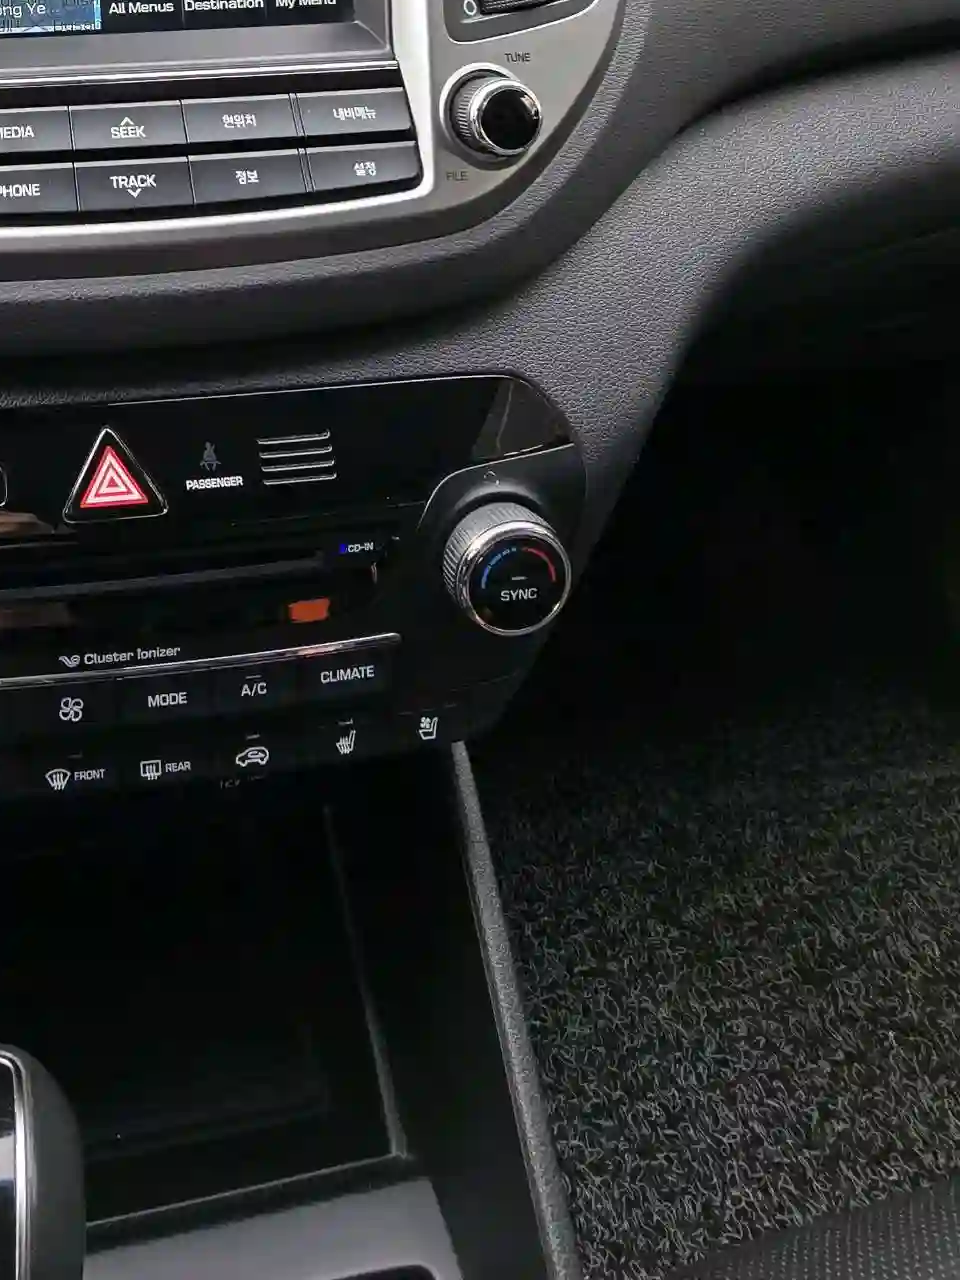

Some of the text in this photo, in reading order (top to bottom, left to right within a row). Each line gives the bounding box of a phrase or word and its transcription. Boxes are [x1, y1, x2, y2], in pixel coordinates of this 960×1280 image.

[109, 1, 174, 14] All Menus
[504, 52, 531, 63] TUNE
[110, 124, 147, 139] SEEK
[109, 173, 157, 190] TRACK
[185, 475, 244, 491] PASSENGER
[347, 541, 375, 553] CD-IN
[500, 587, 538, 601] SYNC
[83, 651, 134, 665] Cluster
[320, 664, 375, 684] CLIMATE
[240, 681, 268, 697] A/C
[147, 691, 188, 708] MODE
[73, 767, 106, 781] FRONT
[165, 760, 191, 774] REAR
